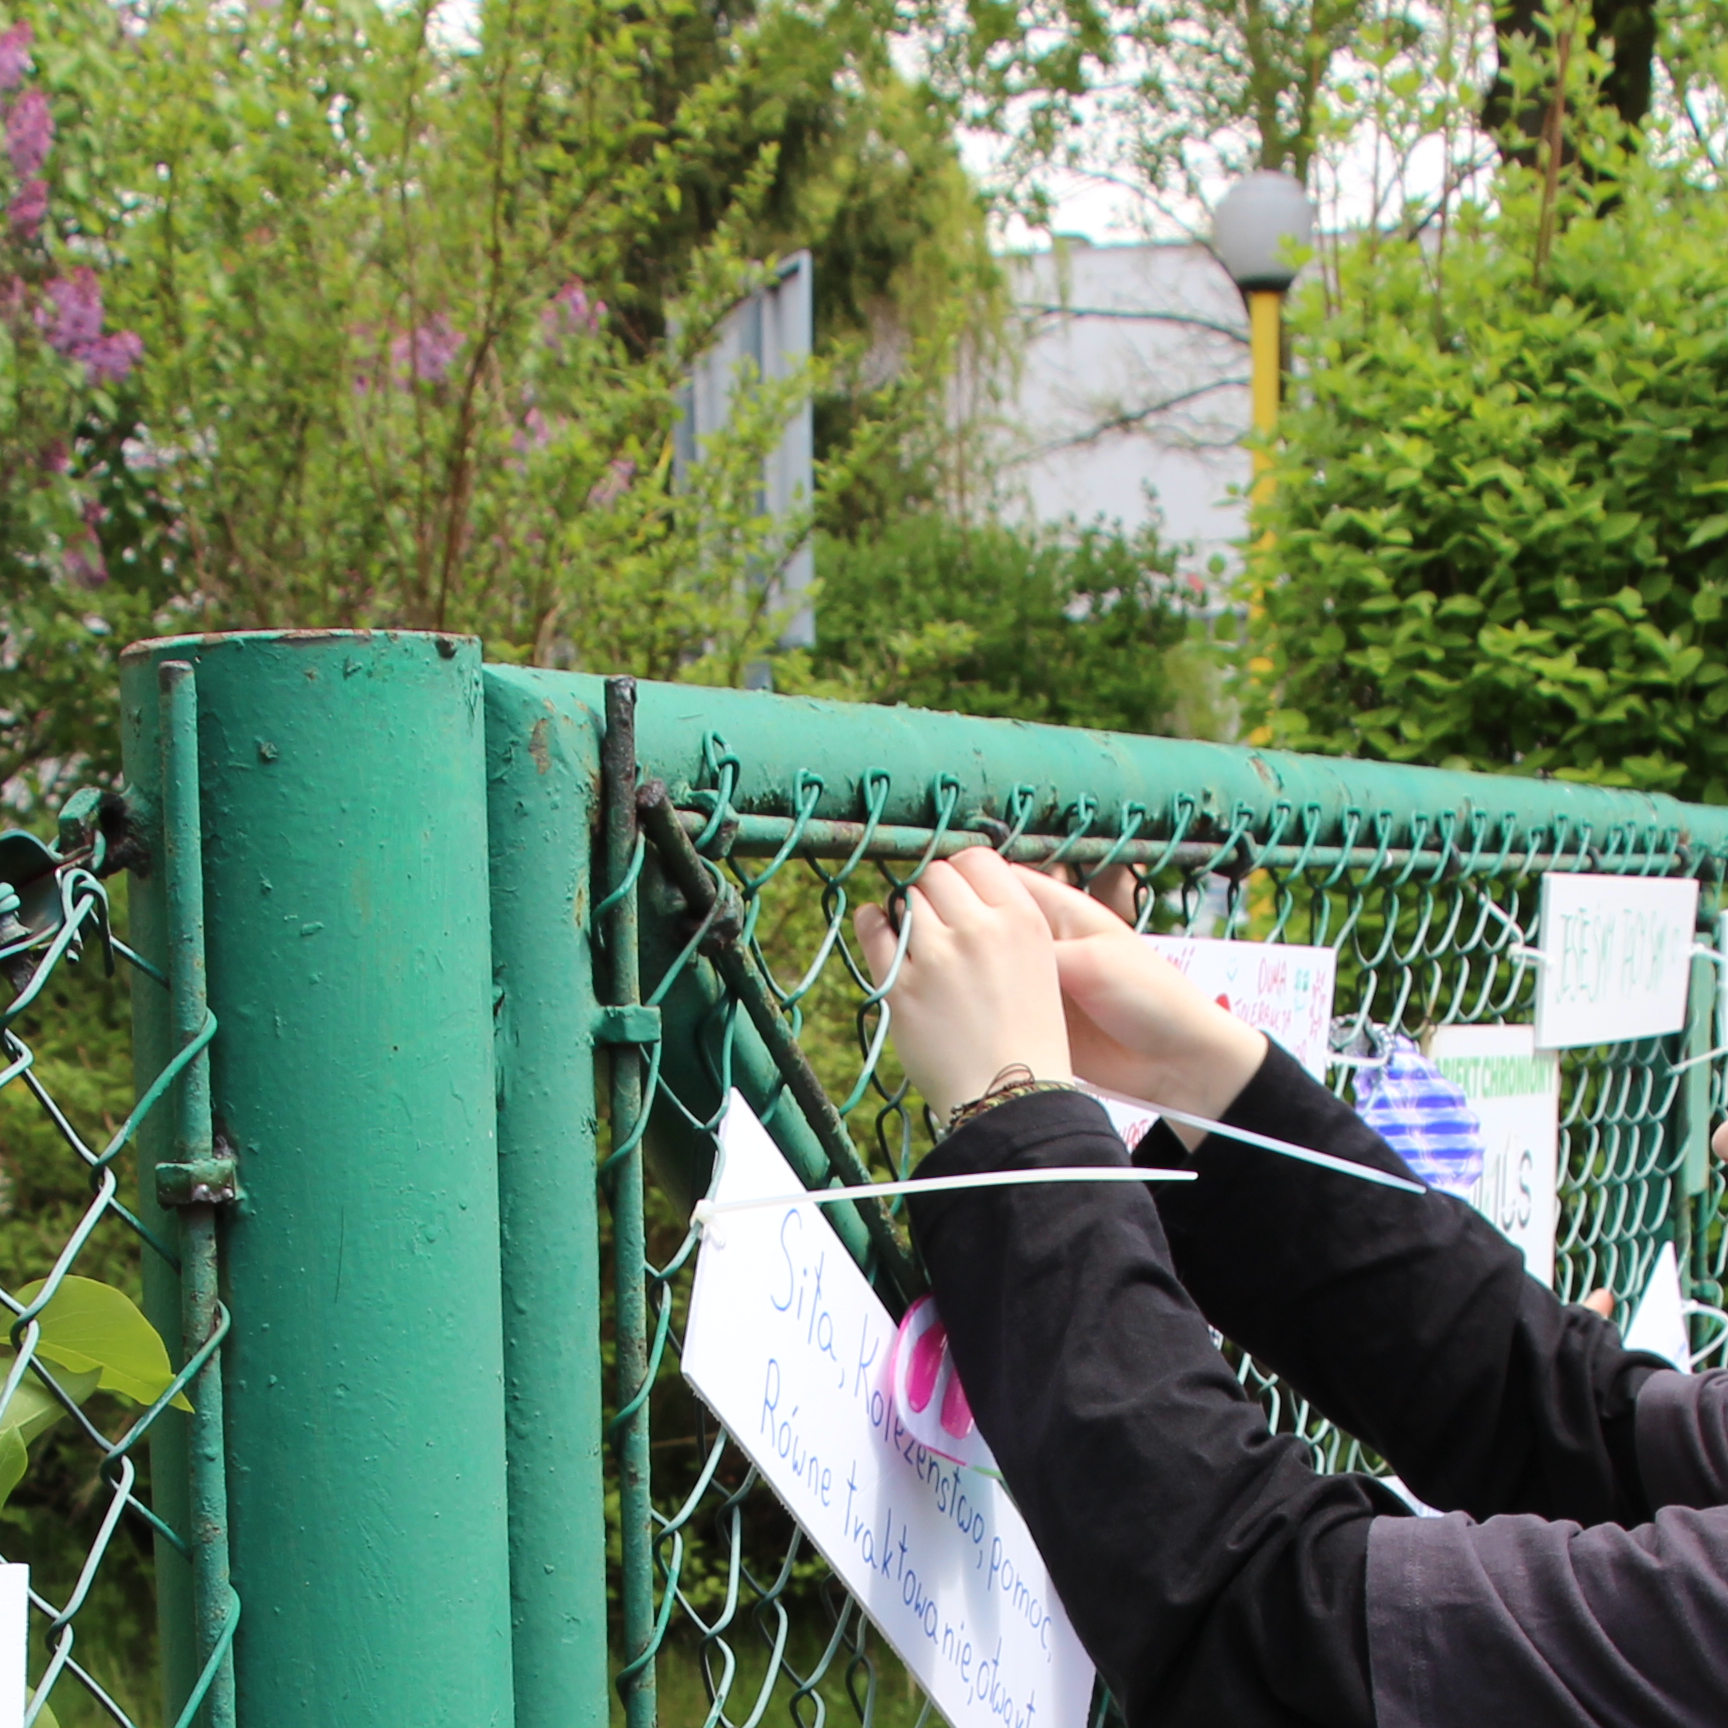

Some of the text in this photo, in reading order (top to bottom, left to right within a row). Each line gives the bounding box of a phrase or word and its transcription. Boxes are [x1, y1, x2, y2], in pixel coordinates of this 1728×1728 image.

[760, 1358, 832, 1507] Równe
[771, 1208, 845, 1389] Siła,
[988, 1536, 1052, 1663] pomoc,
